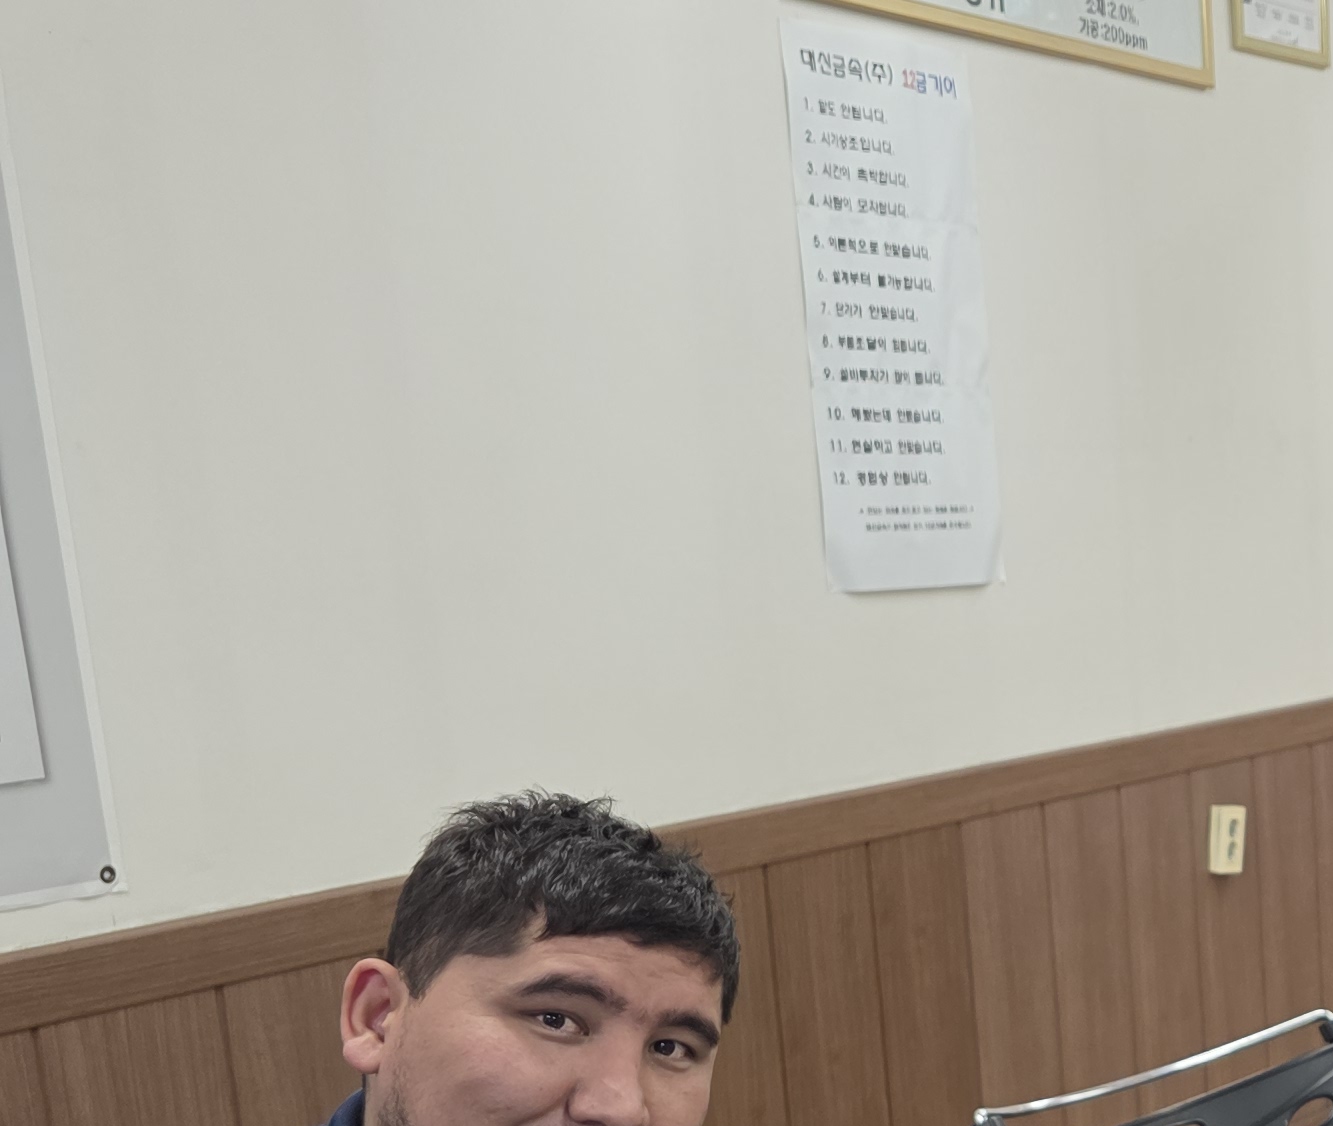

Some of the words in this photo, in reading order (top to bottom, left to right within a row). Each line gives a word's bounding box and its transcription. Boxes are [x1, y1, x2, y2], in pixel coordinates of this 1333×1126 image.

[800, 48, 893, 86] 대신금속(주)
[805, 129, 816, 145] 2.
[821, 130, 895, 155] 시기상조입니다.
[807, 161, 818, 177] 3.
[822, 162, 851, 182] 시간이
[809, 193, 819, 208] 4.
[822, 194, 853, 213] 사람이
[817, 267, 828, 283] 6.
[820, 302, 832, 315] 7.
[823, 368, 835, 381] 9.
[827, 406, 845, 421] 10.
[830, 438, 847, 453] 11.
[833, 471, 850, 486] 12.
